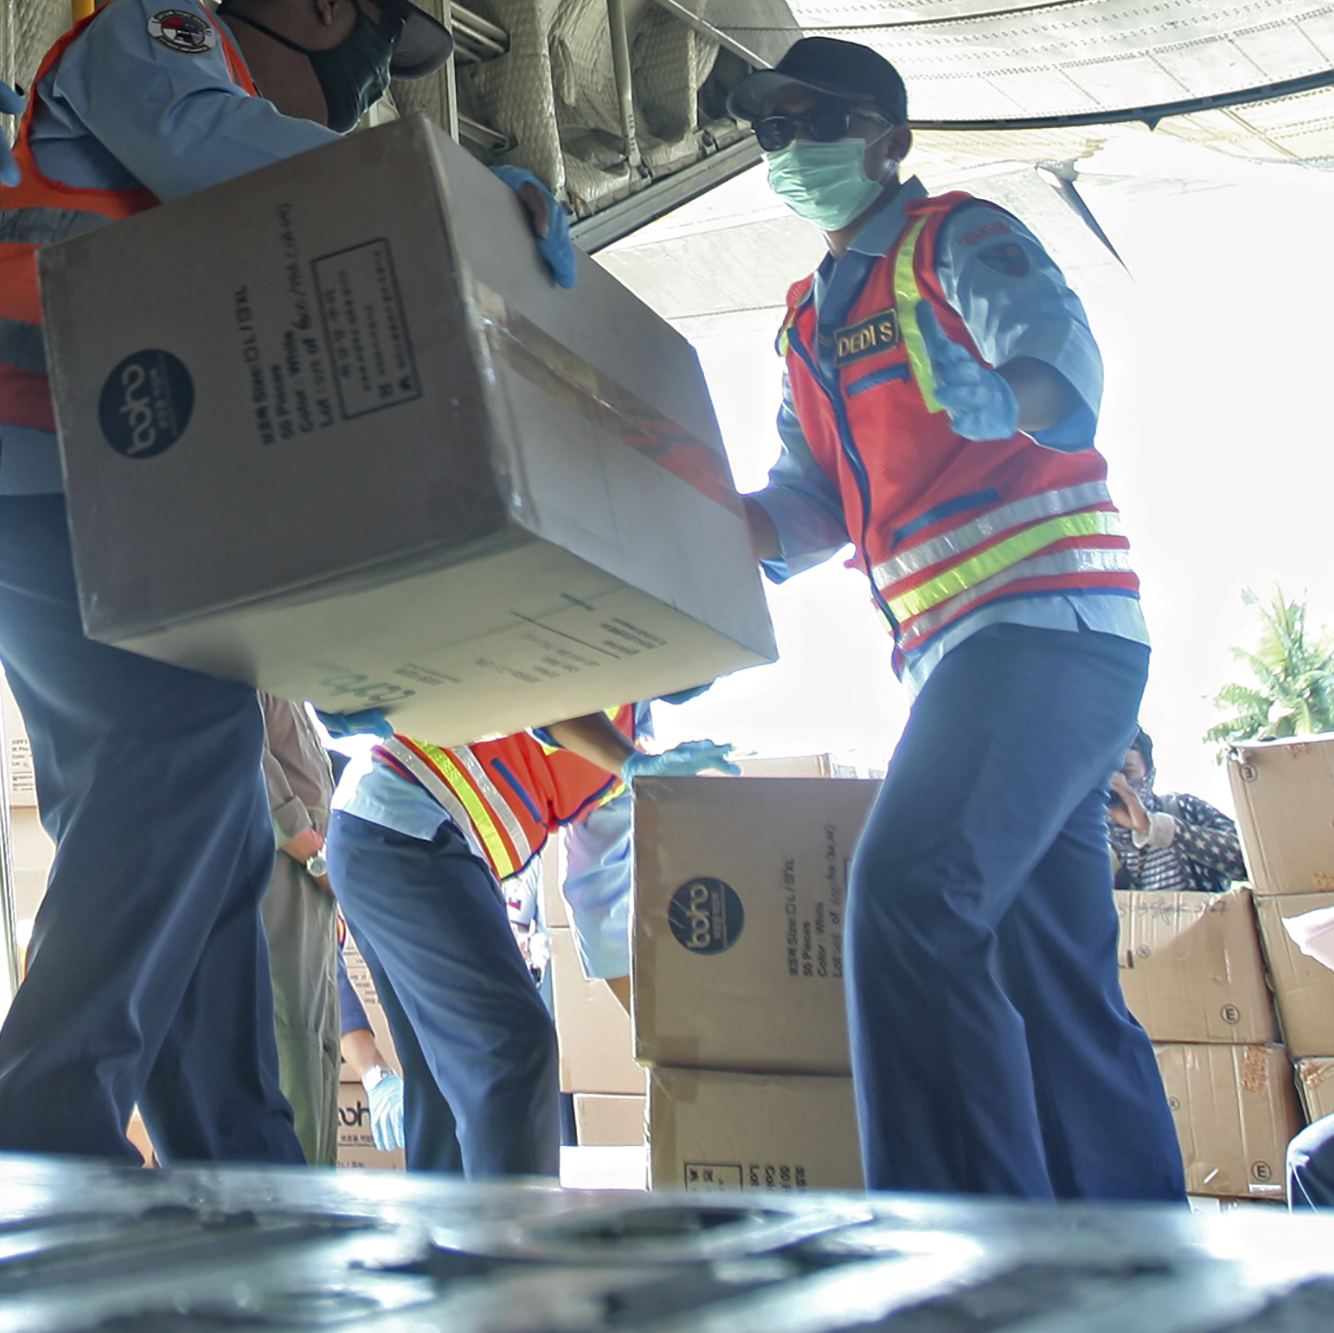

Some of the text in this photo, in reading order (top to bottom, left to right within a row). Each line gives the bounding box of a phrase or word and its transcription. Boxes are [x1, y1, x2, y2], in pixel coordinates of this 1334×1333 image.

[838, 320, 894, 357] DEDI S
[685, 884, 712, 948] boho
[814, 901, 825, 935] White
